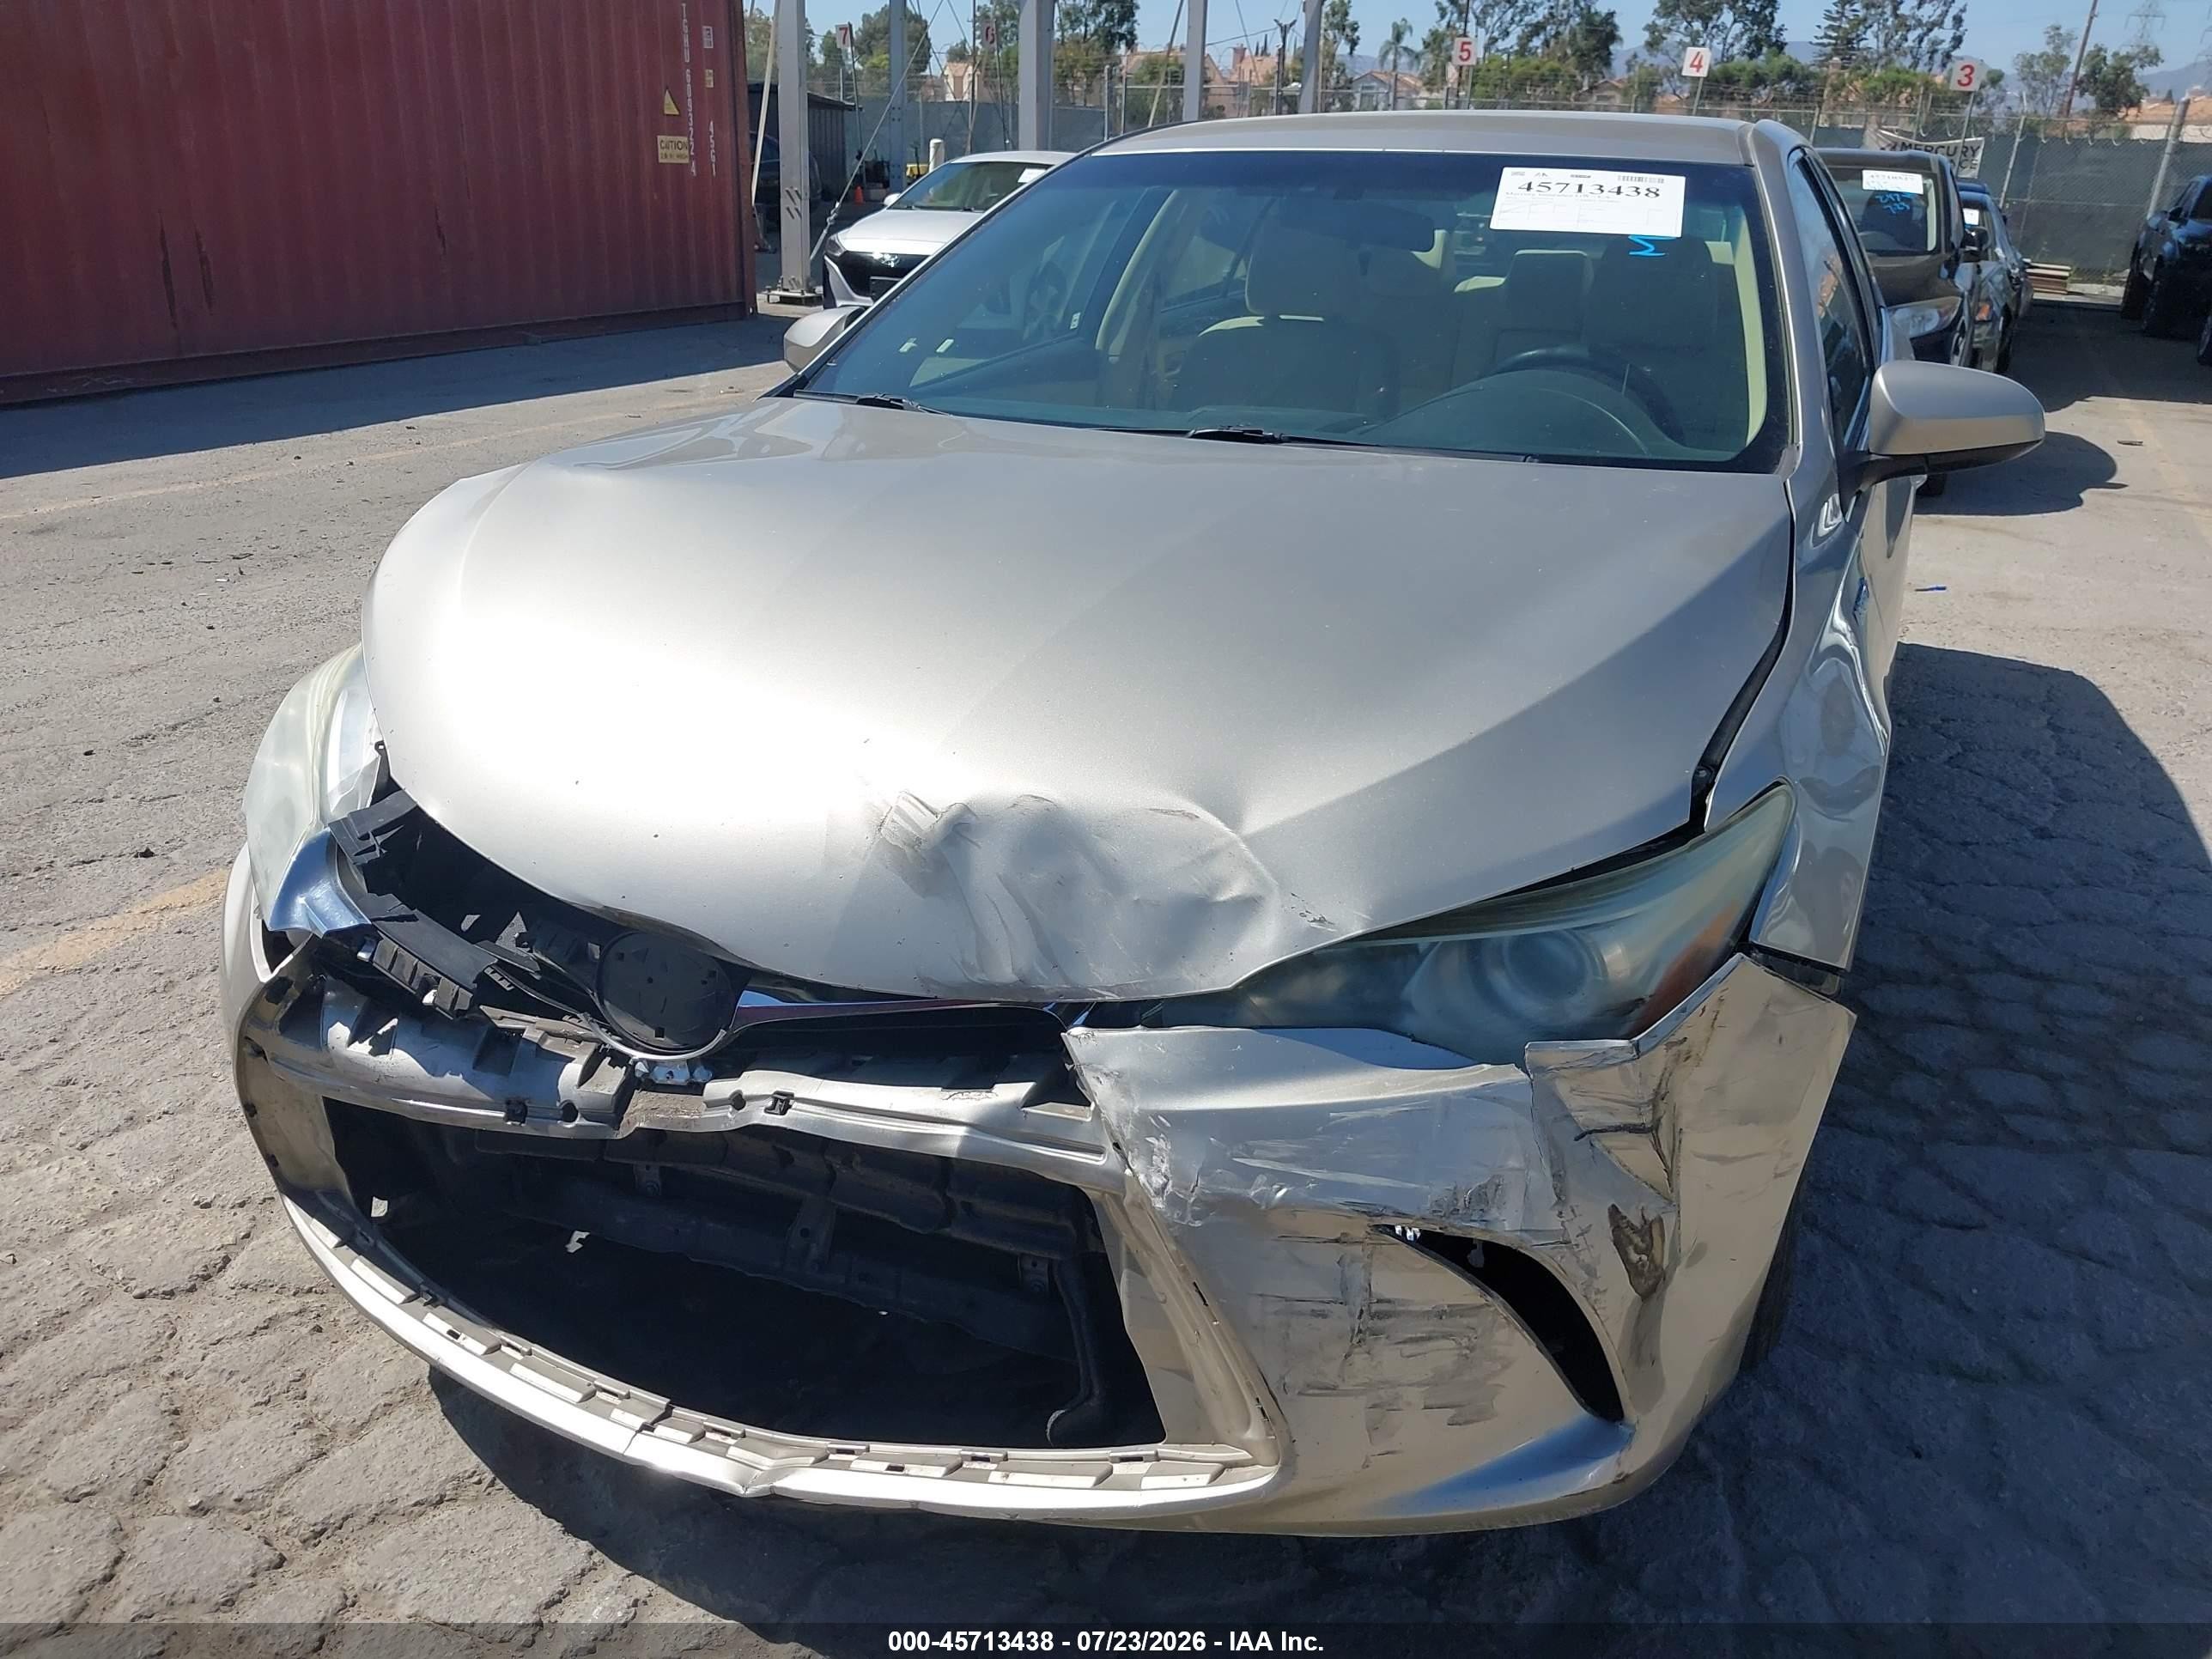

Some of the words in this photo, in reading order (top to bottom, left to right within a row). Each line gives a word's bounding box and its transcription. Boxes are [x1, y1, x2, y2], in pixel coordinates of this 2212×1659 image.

[839, 27, 848, 44] 7
[1458, 41, 1472, 62] 5
[1689, 51, 1703, 73] 4
[1957, 64, 1975, 87] 3
[659, 140, 688, 151] CUTION
[1517, 181, 1661, 198] 45713438
